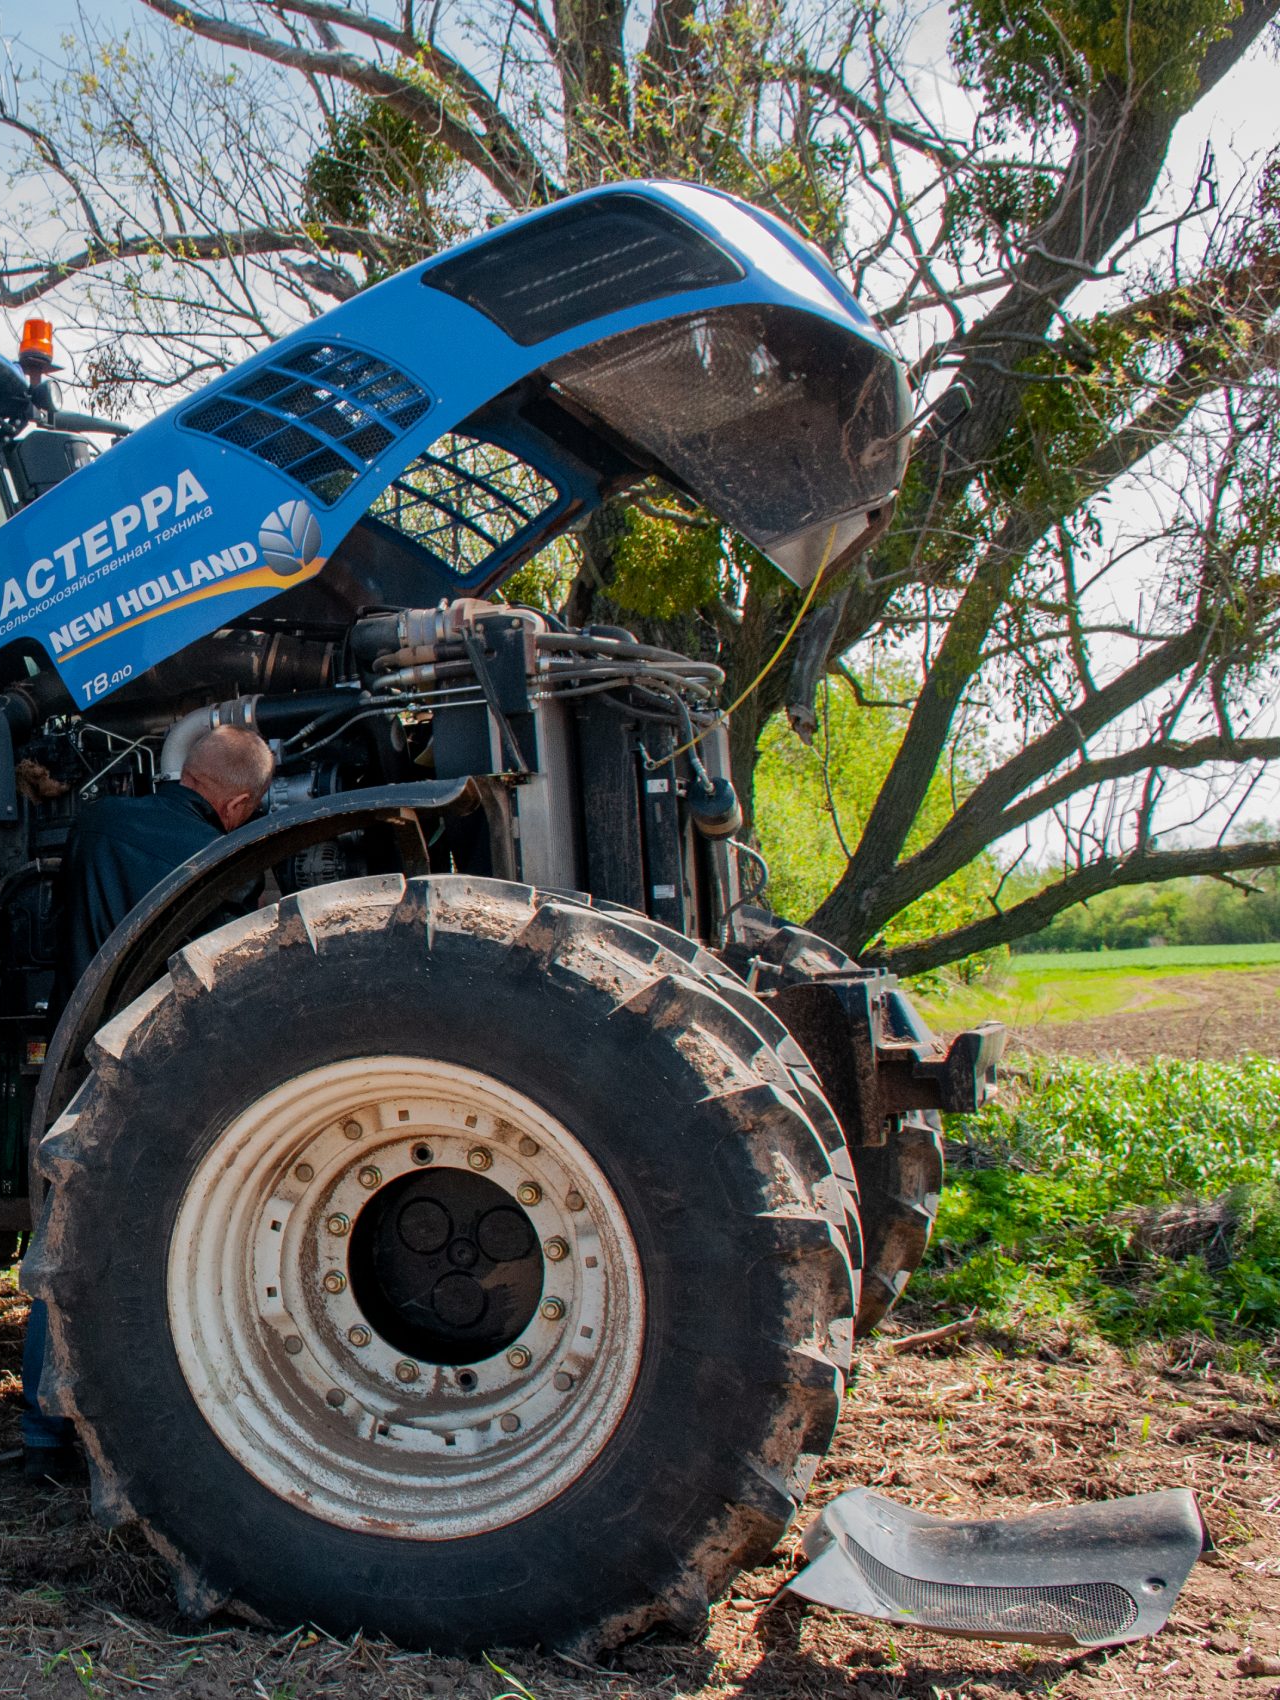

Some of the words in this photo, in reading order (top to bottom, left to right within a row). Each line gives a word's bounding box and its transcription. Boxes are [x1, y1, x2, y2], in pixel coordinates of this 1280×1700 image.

[0, 469, 209, 621] АСТЕРРА
[154, 505, 214, 546] техника
[48, 606, 114, 655] NEW
[116, 541, 258, 617] HOLLAND
